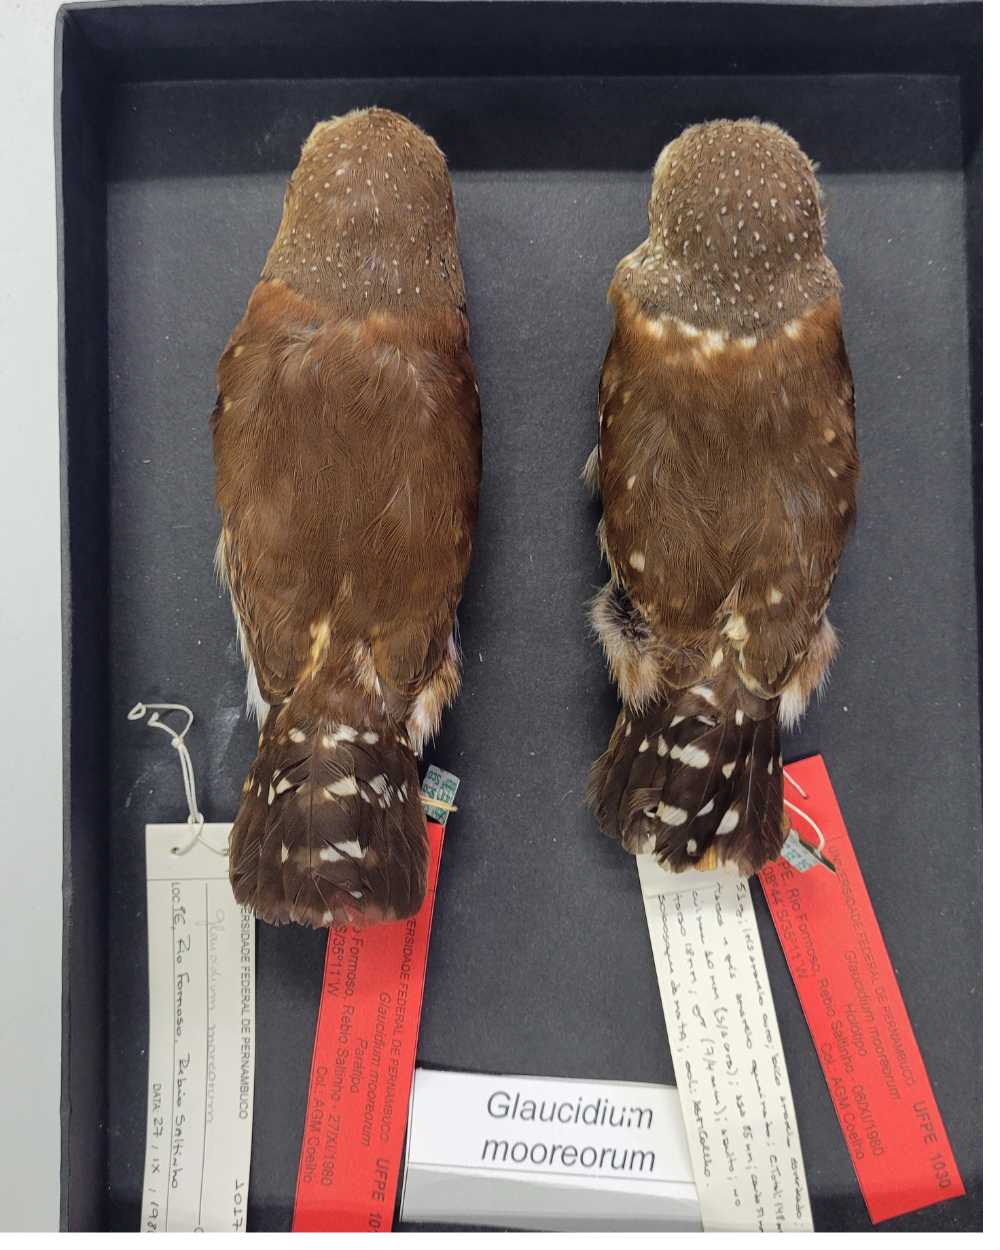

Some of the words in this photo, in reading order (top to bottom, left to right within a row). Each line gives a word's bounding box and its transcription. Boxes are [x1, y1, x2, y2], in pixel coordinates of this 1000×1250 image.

[827, 846, 862, 929] UNIVERSIDADE
[176, 934, 191, 964] Rio
[240, 907, 252, 962] ERSIDADE
[856, 931, 881, 985] FEDERAL
[240, 966, 251, 1015] FEDERAL
[342, 936, 363, 1000] Formoso,
[874, 986, 889, 1004] DE
[173, 972, 190, 1043] Formoso,
[241, 1018, 250, 1033] DE
[338, 1004, 355, 1044] Rebio
[371, 992, 391, 1066] Glaucidium
[392, 982, 409, 1036] FEDERAL
[777, 859, 795, 886] PE,
[786, 887, 802, 912] Rio
[794, 912, 821, 977] Formoso,
[817, 977, 837, 1018] Rebio
[830, 1019, 855, 1074] Saltinho
[851, 1084, 885, 1157] 06/XI/1980
[840, 1002, 871, 1058] Holótipo
[843, 949, 876, 1023] Glaucidium
[866, 1026, 901, 1101] mooreorum
[390, 1038, 402, 1055] DE
[880, 1004, 916, 1087] PERNAMBUCO
[152, 1083, 161, 1112] DATA:
[176, 1052, 191, 1107] Rebio
[238, 1036, 250, 1119] PERNAMBUCO
[330, 1047, 349, 1101] Saltinho
[379, 1057, 399, 1142] PERNAMBUCO
[152, 1116, 163, 1137] 27
[309, 1097, 325, 1133] AGM
[360, 1069, 379, 1147] mooreorum
[486, 1090, 654, 1129] Glaucidium
[829, 1075, 852, 1110] AGM
[843, 1111, 865, 1161] Coelho
[151, 1158, 160, 1174] IX
[302, 1136, 320, 1184] Coelho
[320, 1113, 341, 1186] 27/XI/1980
[481, 1138, 656, 1172] mooreorum
[912, 1099, 938, 1145] UFPE
[929, 1152, 952, 1190] 1030
[232, 1178, 244, 1231] 1017
[371, 1158, 390, 1202] UFPE
